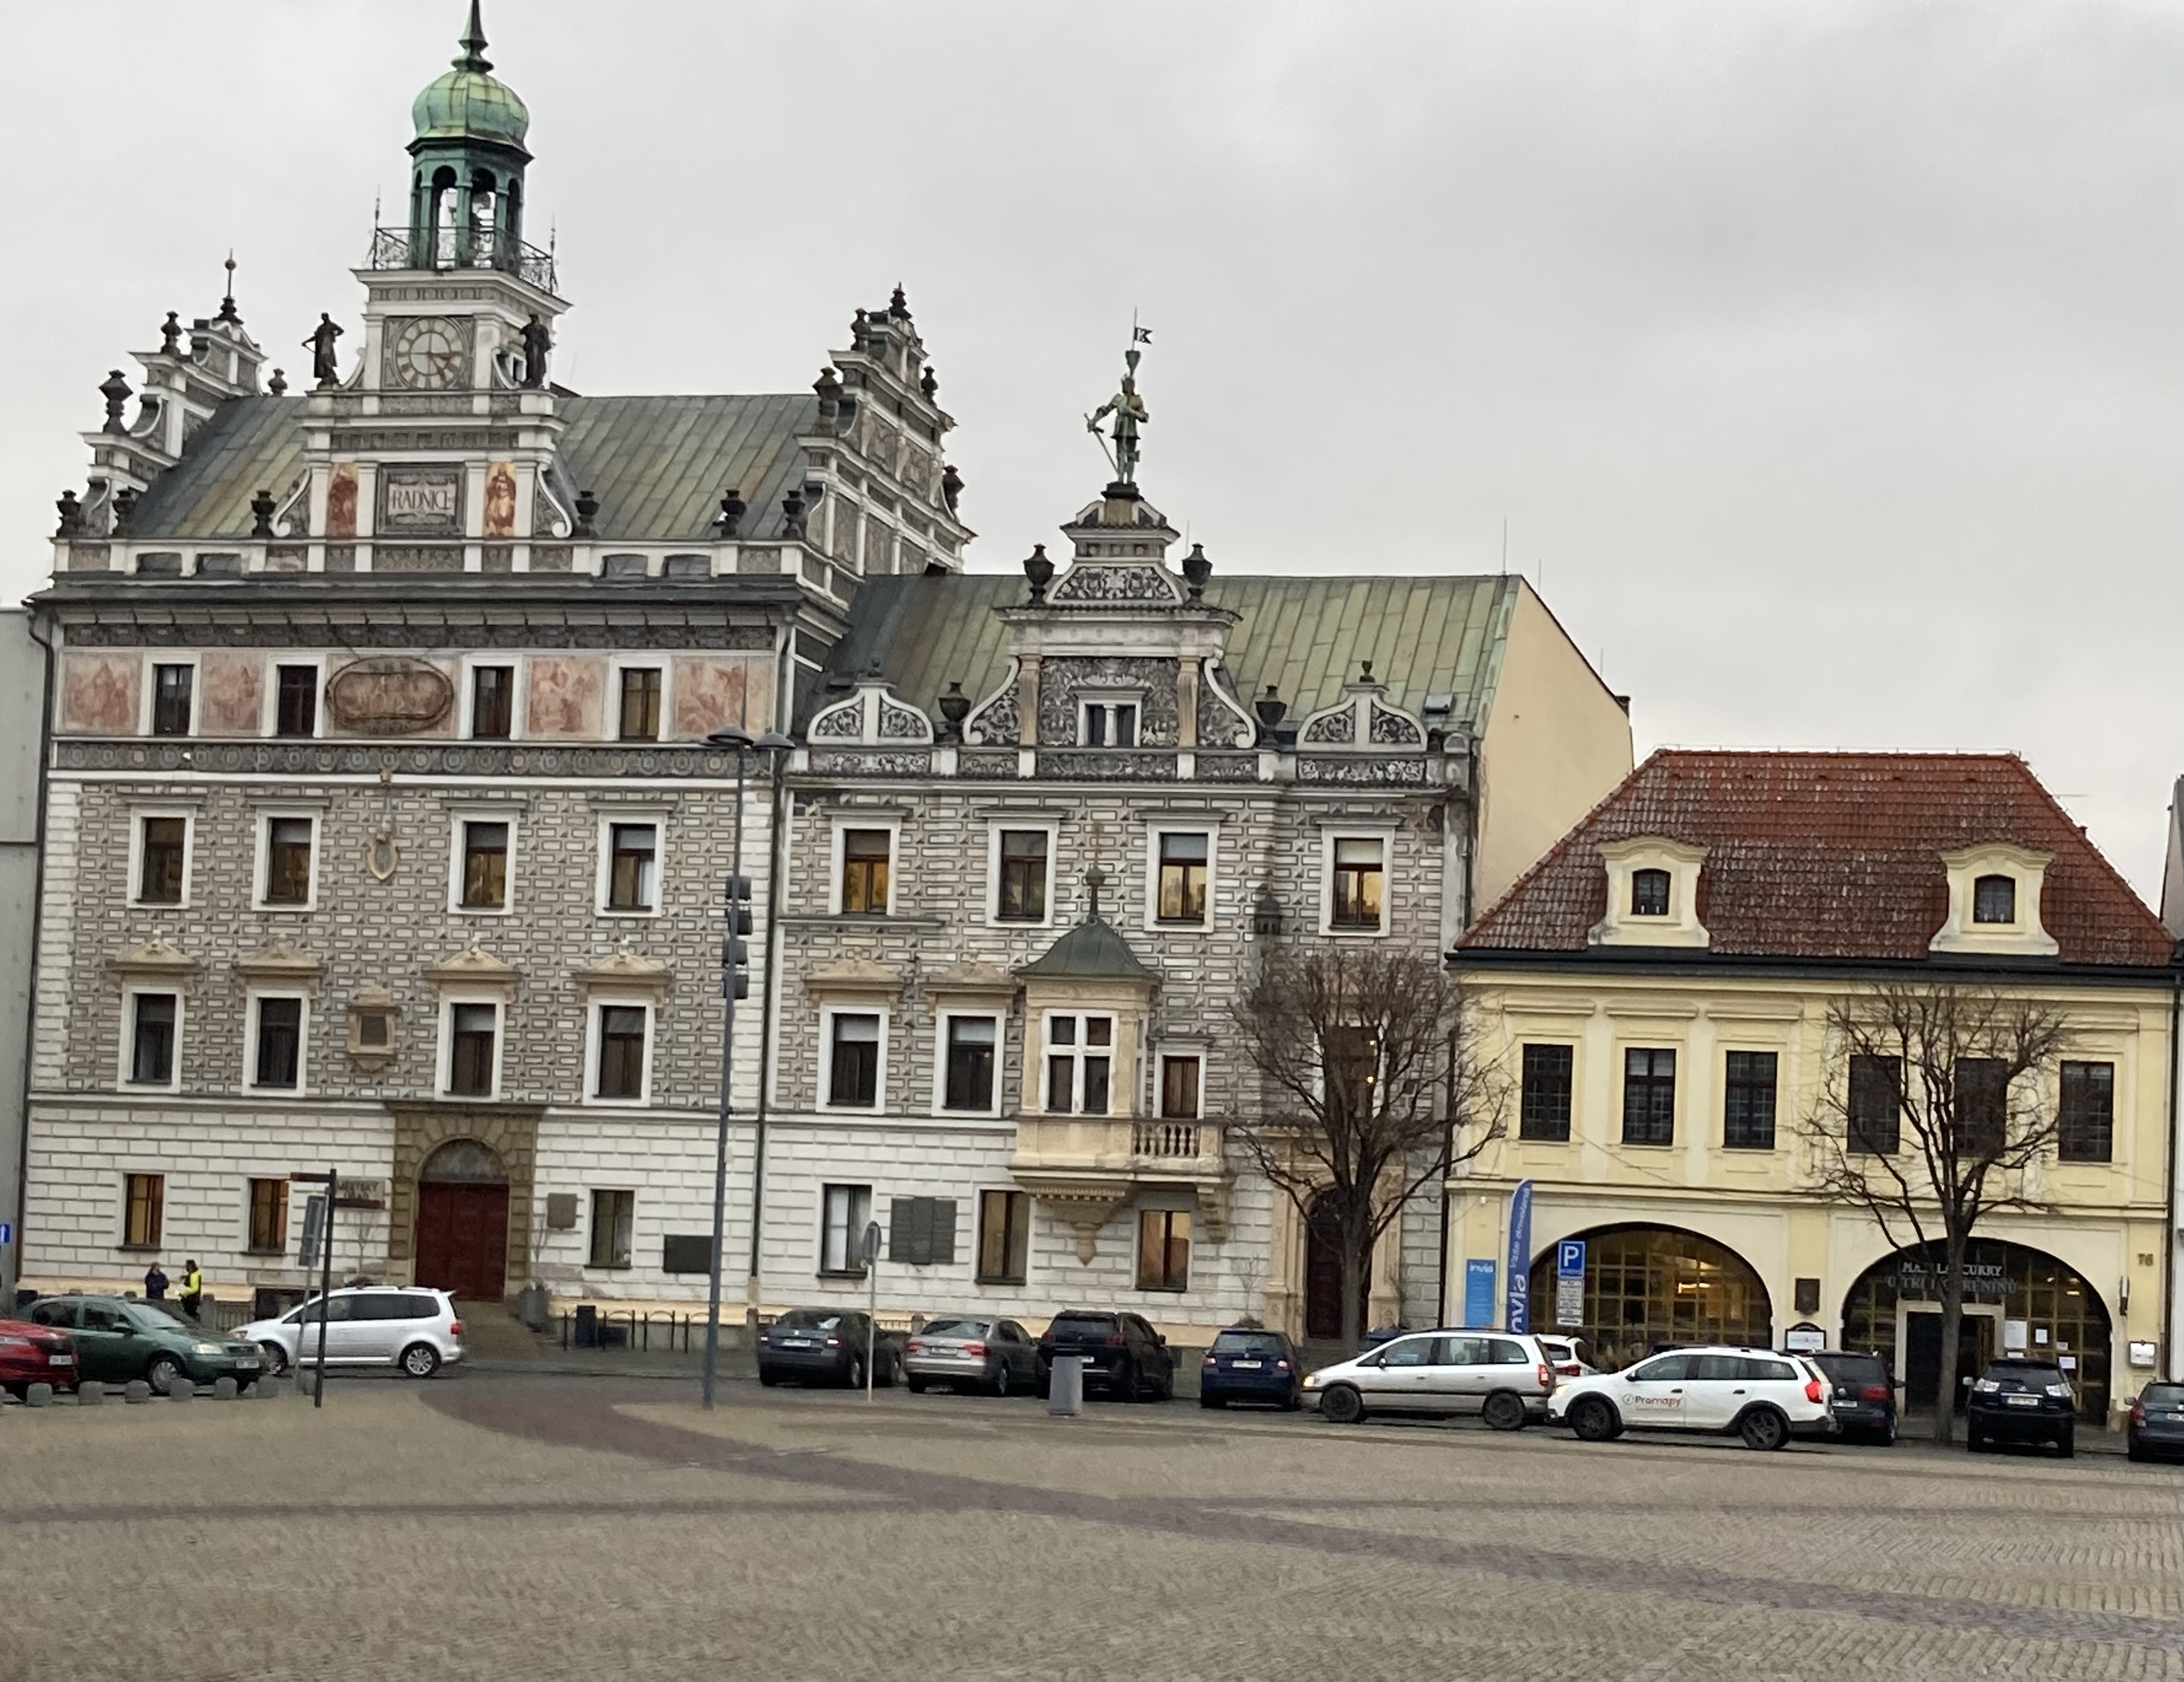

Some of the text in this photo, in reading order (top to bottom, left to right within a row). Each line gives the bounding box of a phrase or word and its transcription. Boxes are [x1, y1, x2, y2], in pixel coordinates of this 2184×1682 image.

[1564, 1246, 1579, 1267] P
[1469, 1263, 1494, 1273] invia
[1902, 1261, 1949, 1274] MAL
[1509, 1274, 1526, 1333] nvia
[1635, 1396, 1682, 1408] Promapy
